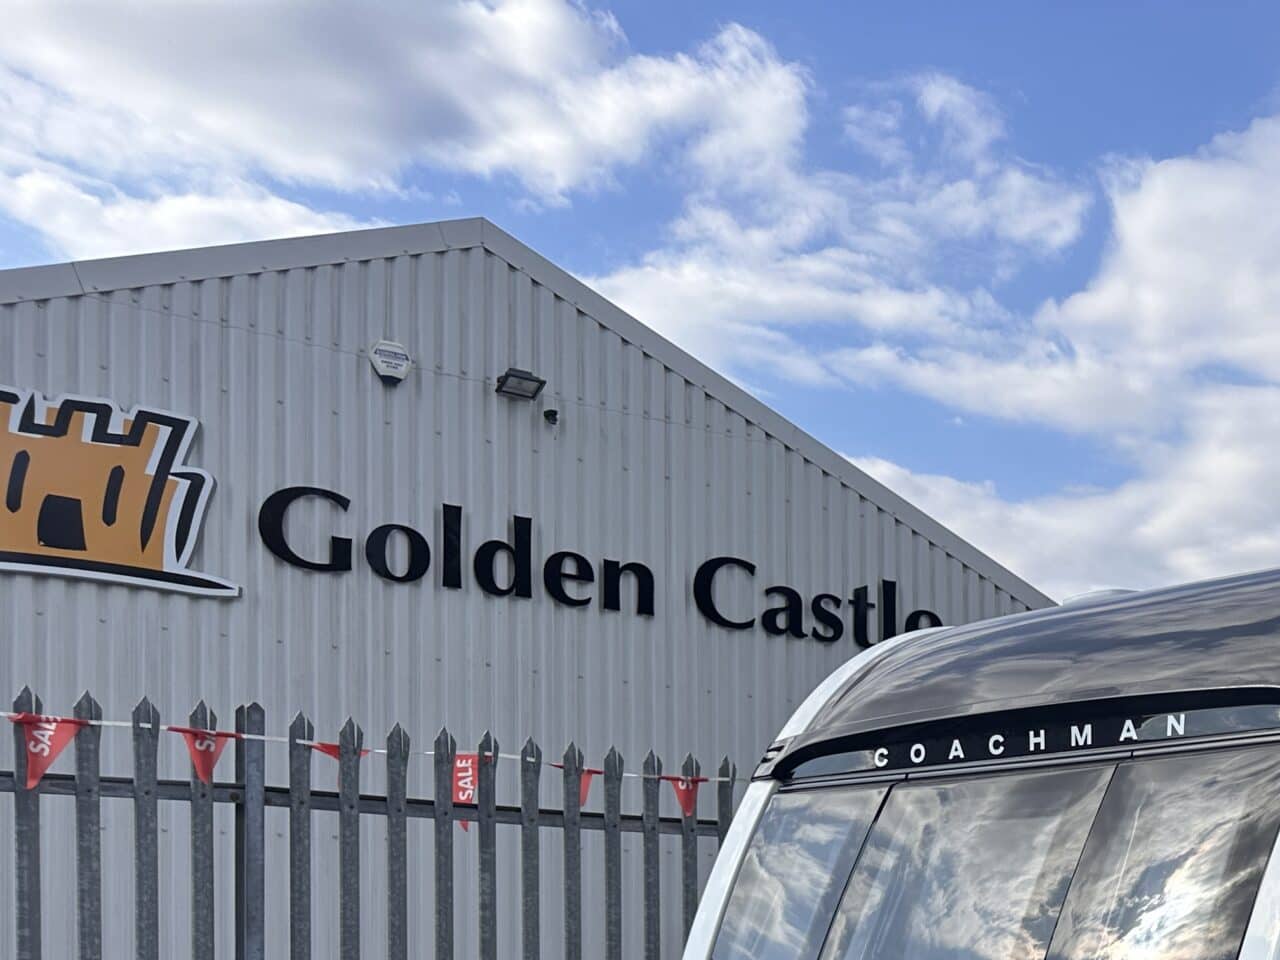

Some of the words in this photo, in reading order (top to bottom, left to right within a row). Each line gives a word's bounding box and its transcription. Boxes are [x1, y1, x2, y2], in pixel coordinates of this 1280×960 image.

[258, 486, 655, 617] Golden
[873, 713, 1186, 768] COACHMAN
[456, 758, 474, 801] SALE
